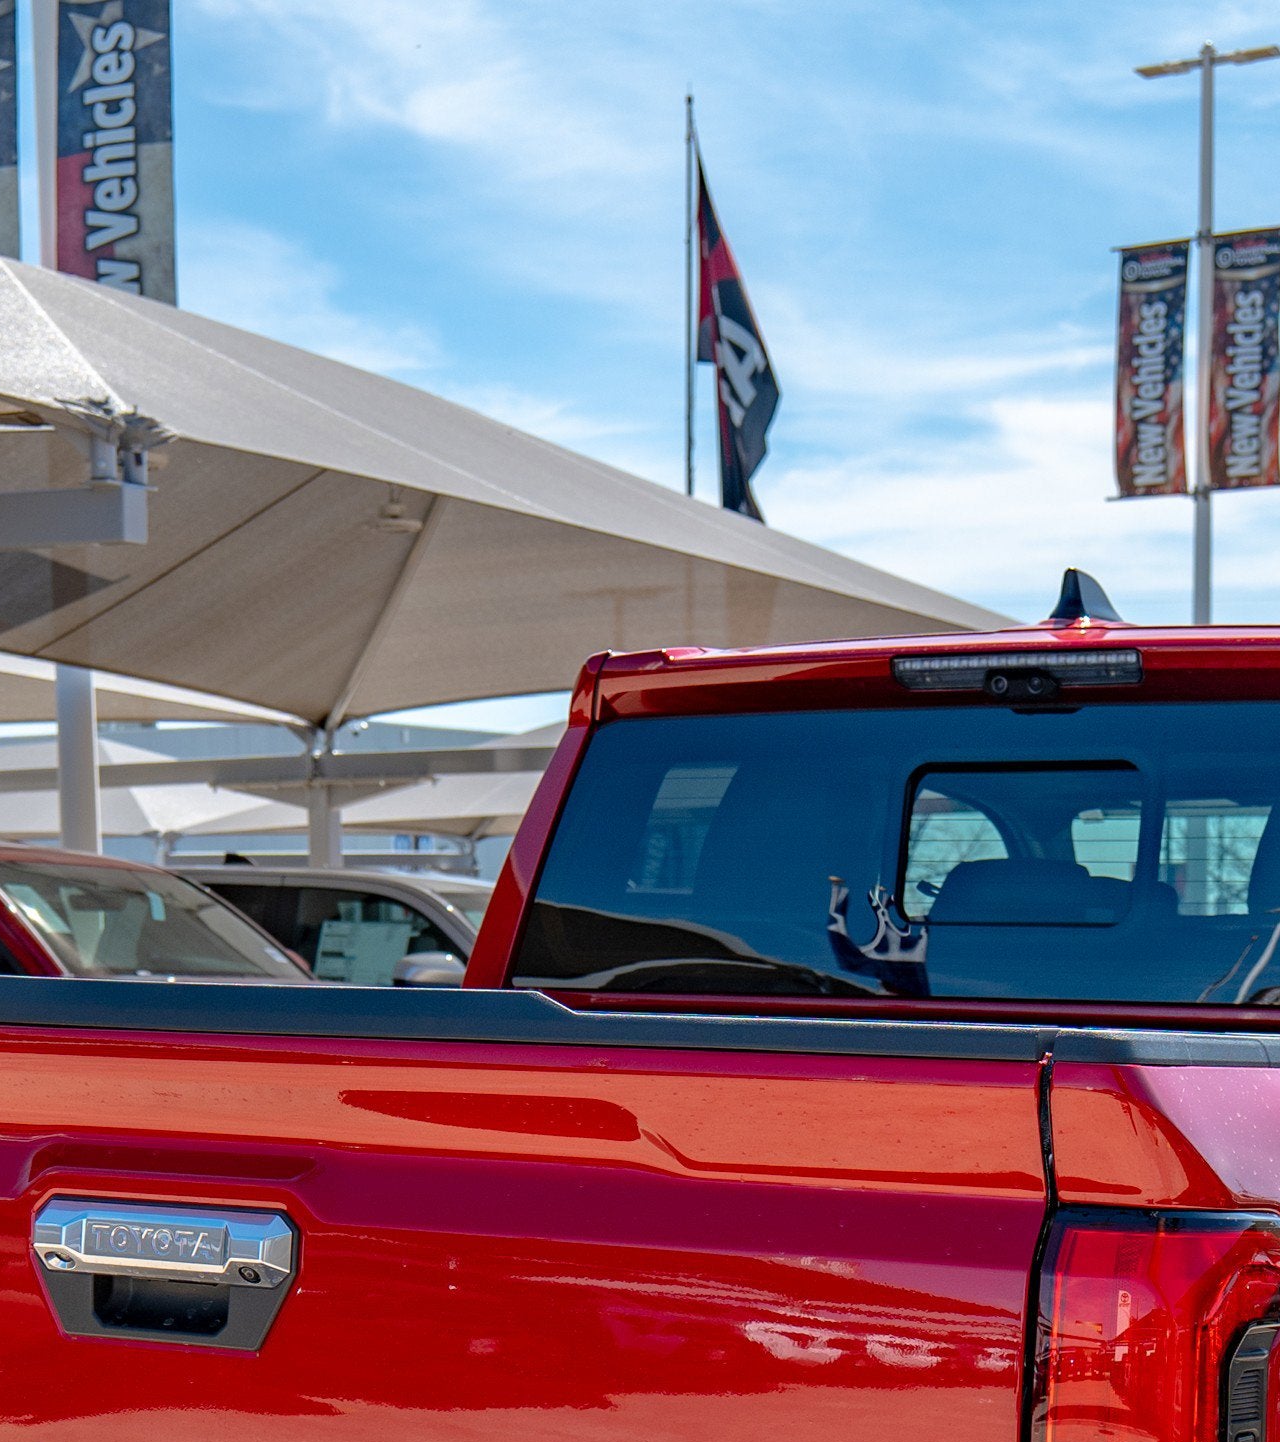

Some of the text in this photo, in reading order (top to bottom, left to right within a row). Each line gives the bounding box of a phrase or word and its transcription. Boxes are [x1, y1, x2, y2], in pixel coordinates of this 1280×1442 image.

[82, 20, 138, 250] Vehicles
[1130, 300, 1168, 421] Vehicles
[1224, 289, 1264, 411] Vehicles
[1132, 421, 1167, 486] New
[1225, 412, 1263, 478] New
[91, 1223, 215, 1260] TOYOTA
